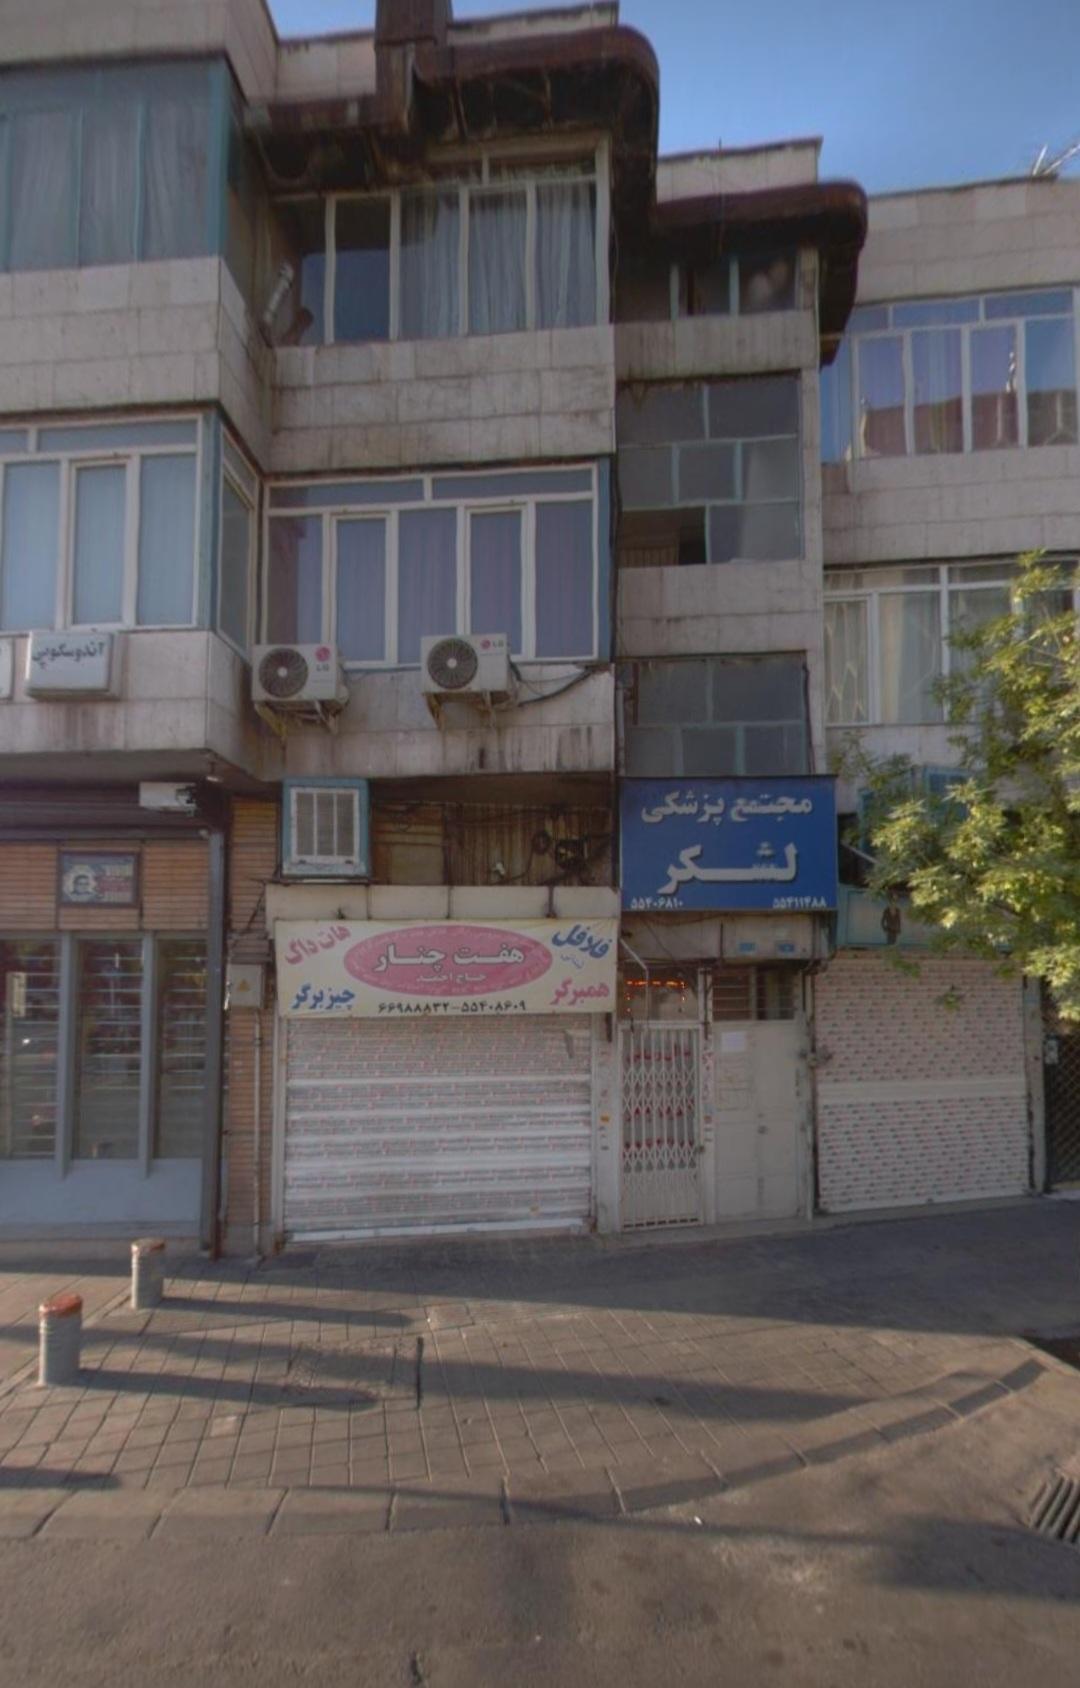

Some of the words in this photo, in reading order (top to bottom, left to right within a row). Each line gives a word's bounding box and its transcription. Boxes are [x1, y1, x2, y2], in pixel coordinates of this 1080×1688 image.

[32, 642, 104, 670] آندوسکوپی
[641, 790, 725, 826] پزشکی
[730, 793, 813, 822] مجتمع
[657, 841, 798, 895] لشکر
[284, 938, 318, 965] داگ
[317, 925, 351, 949] هات
[552, 924, 613, 959] فلافل
[372, 942, 447, 973] چنار
[453, 942, 525, 967] هفت
[549, 976, 609, 1006] همبرگر
